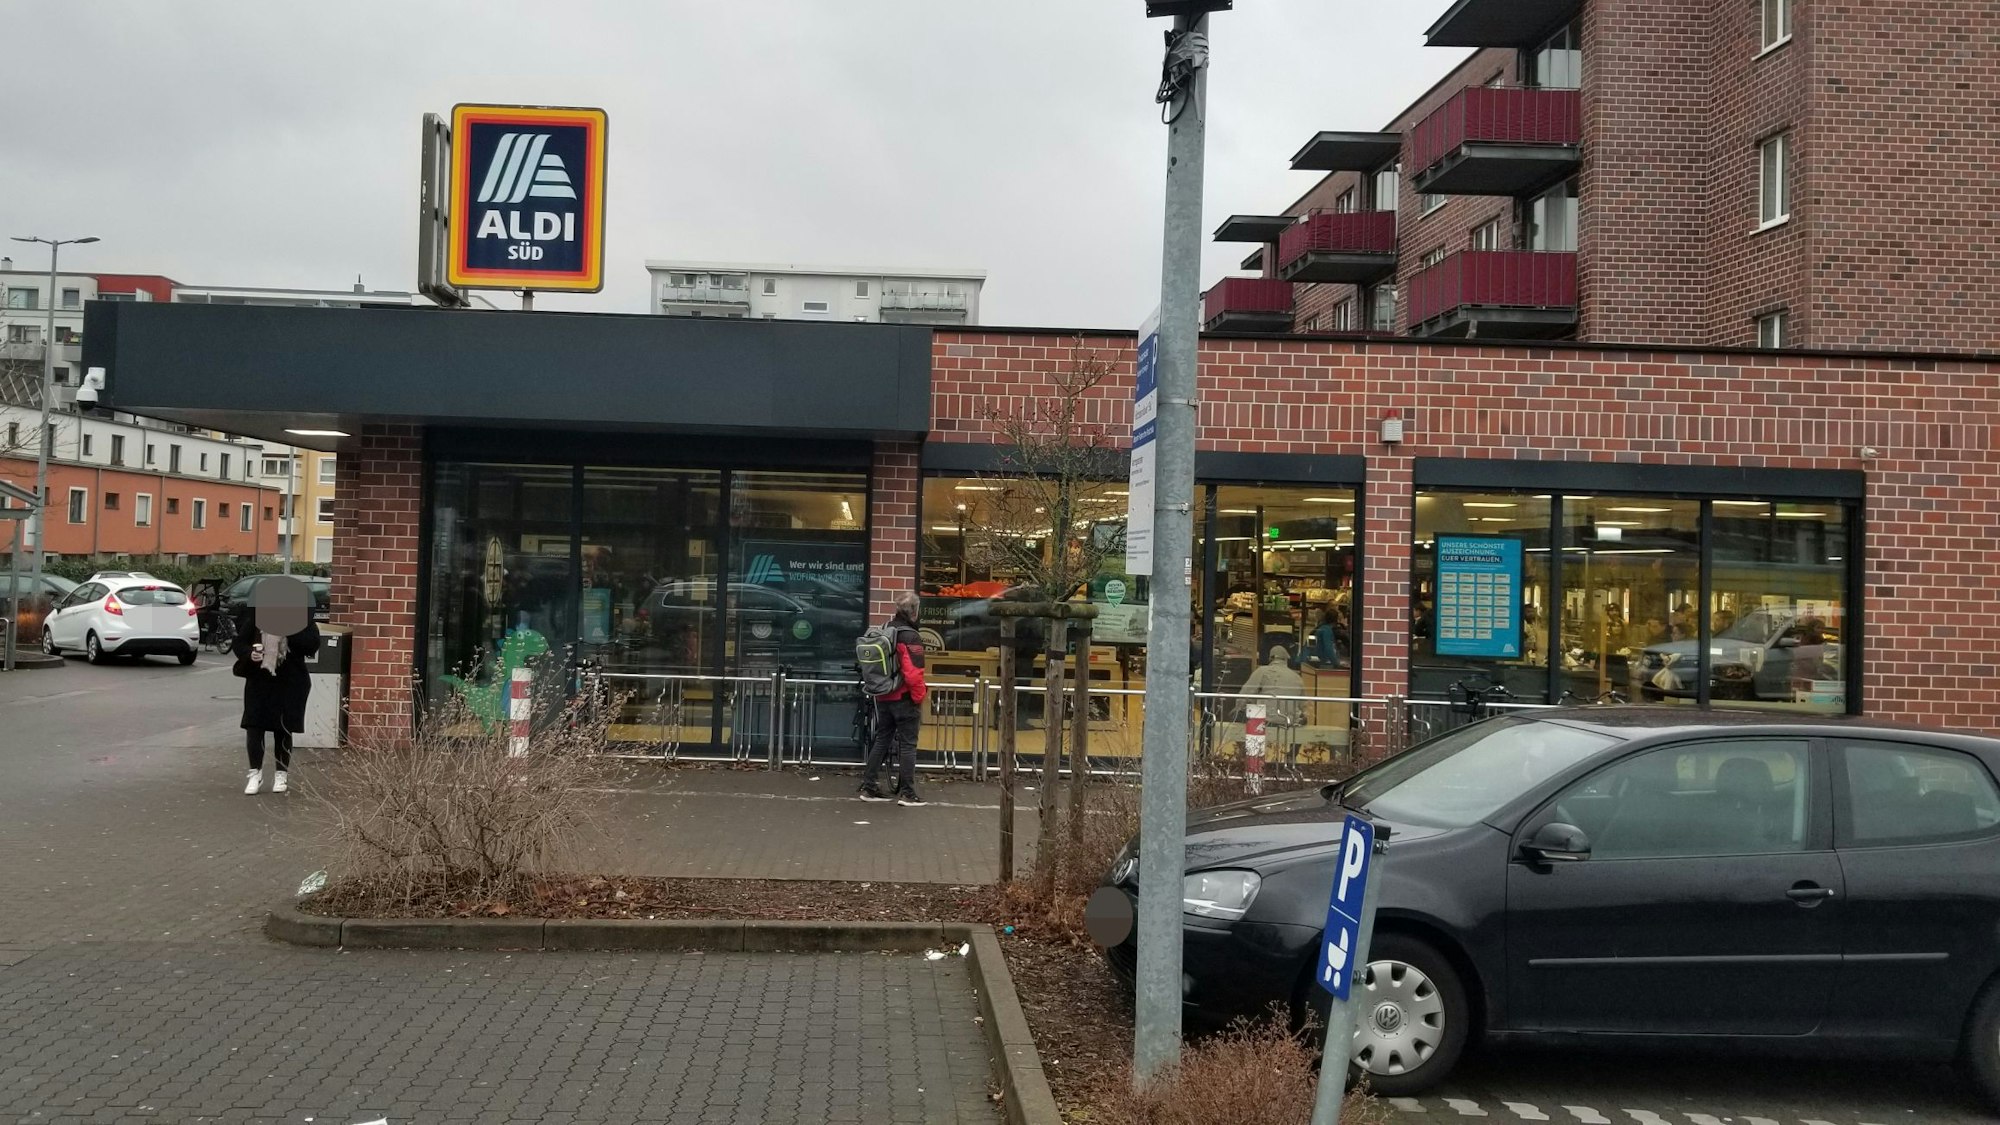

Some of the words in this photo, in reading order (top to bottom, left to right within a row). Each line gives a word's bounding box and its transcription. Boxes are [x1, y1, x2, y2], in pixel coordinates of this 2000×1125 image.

[476, 209, 575, 242] ALDI
[508, 241, 544, 261] SÜD
[789, 560, 806, 569] Wer
[808, 560, 823, 569] wir
[825, 561, 844, 570] sind
[846, 563, 864, 571] und
[1460, 555, 1502, 563] VERTRAUEN.
[1338, 827, 1365, 902] P
